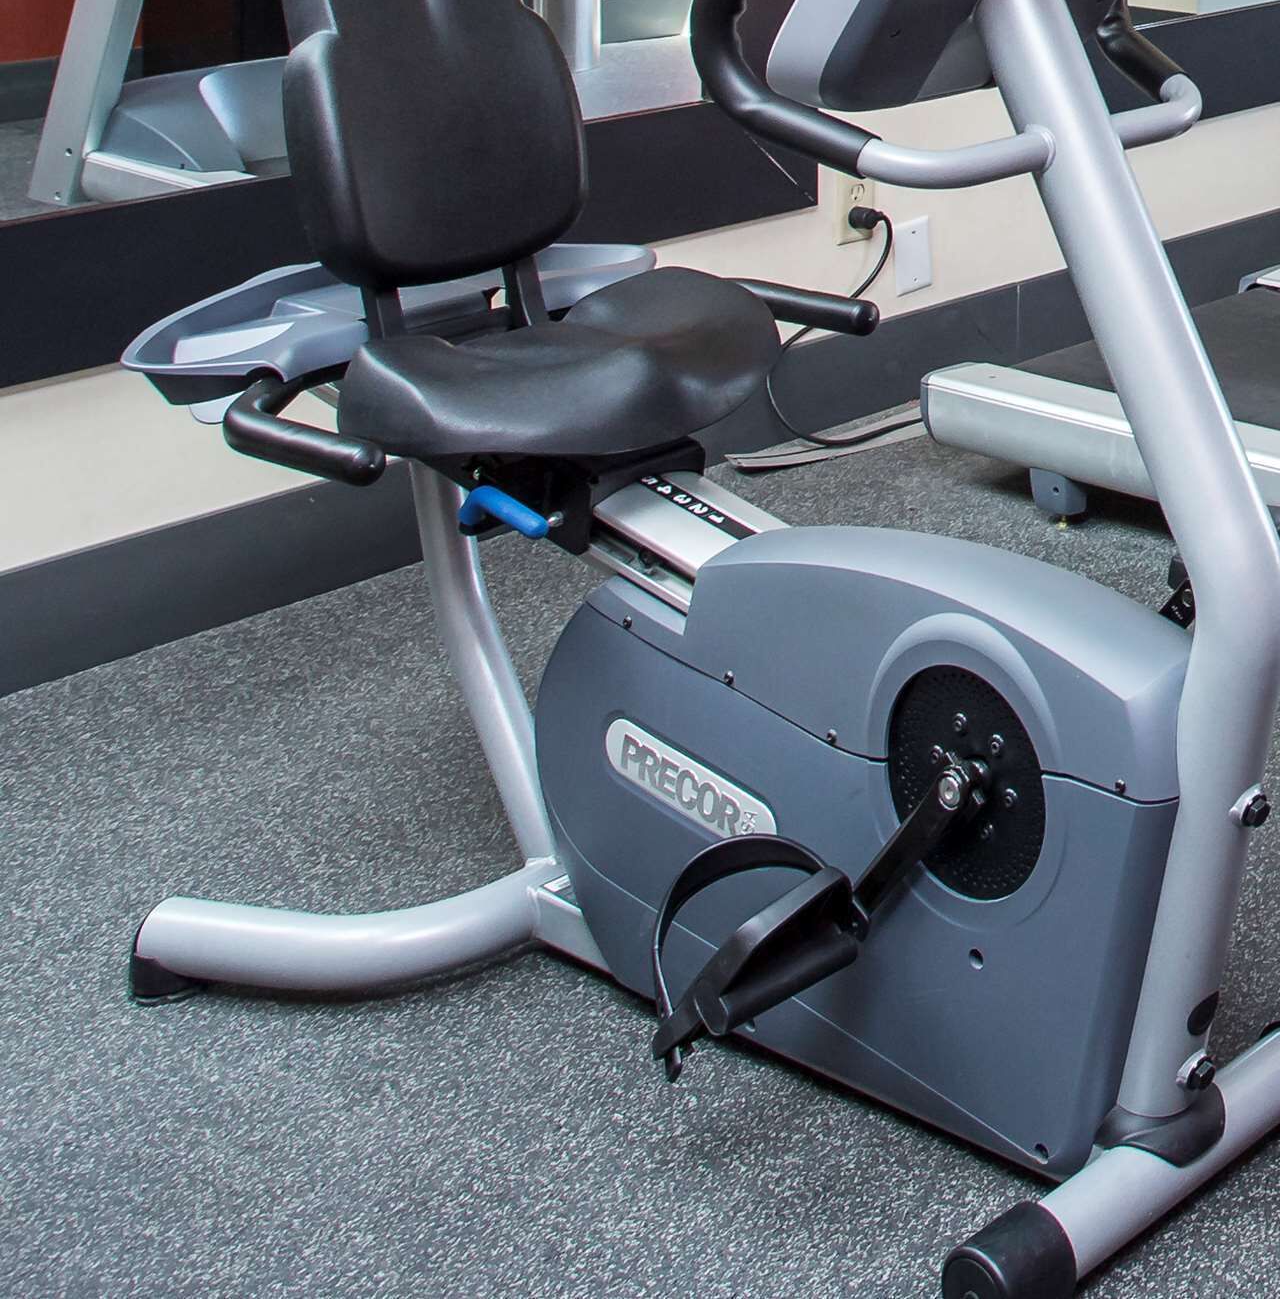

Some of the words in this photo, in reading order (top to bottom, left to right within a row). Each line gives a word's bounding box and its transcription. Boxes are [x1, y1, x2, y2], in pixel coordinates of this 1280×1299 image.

[657, 484, 672, 495] 4
[673, 494, 692, 504] 3
[688, 503, 709, 515] 2
[708, 514, 726, 524] 1
[620, 733, 741, 836] PRECOR
